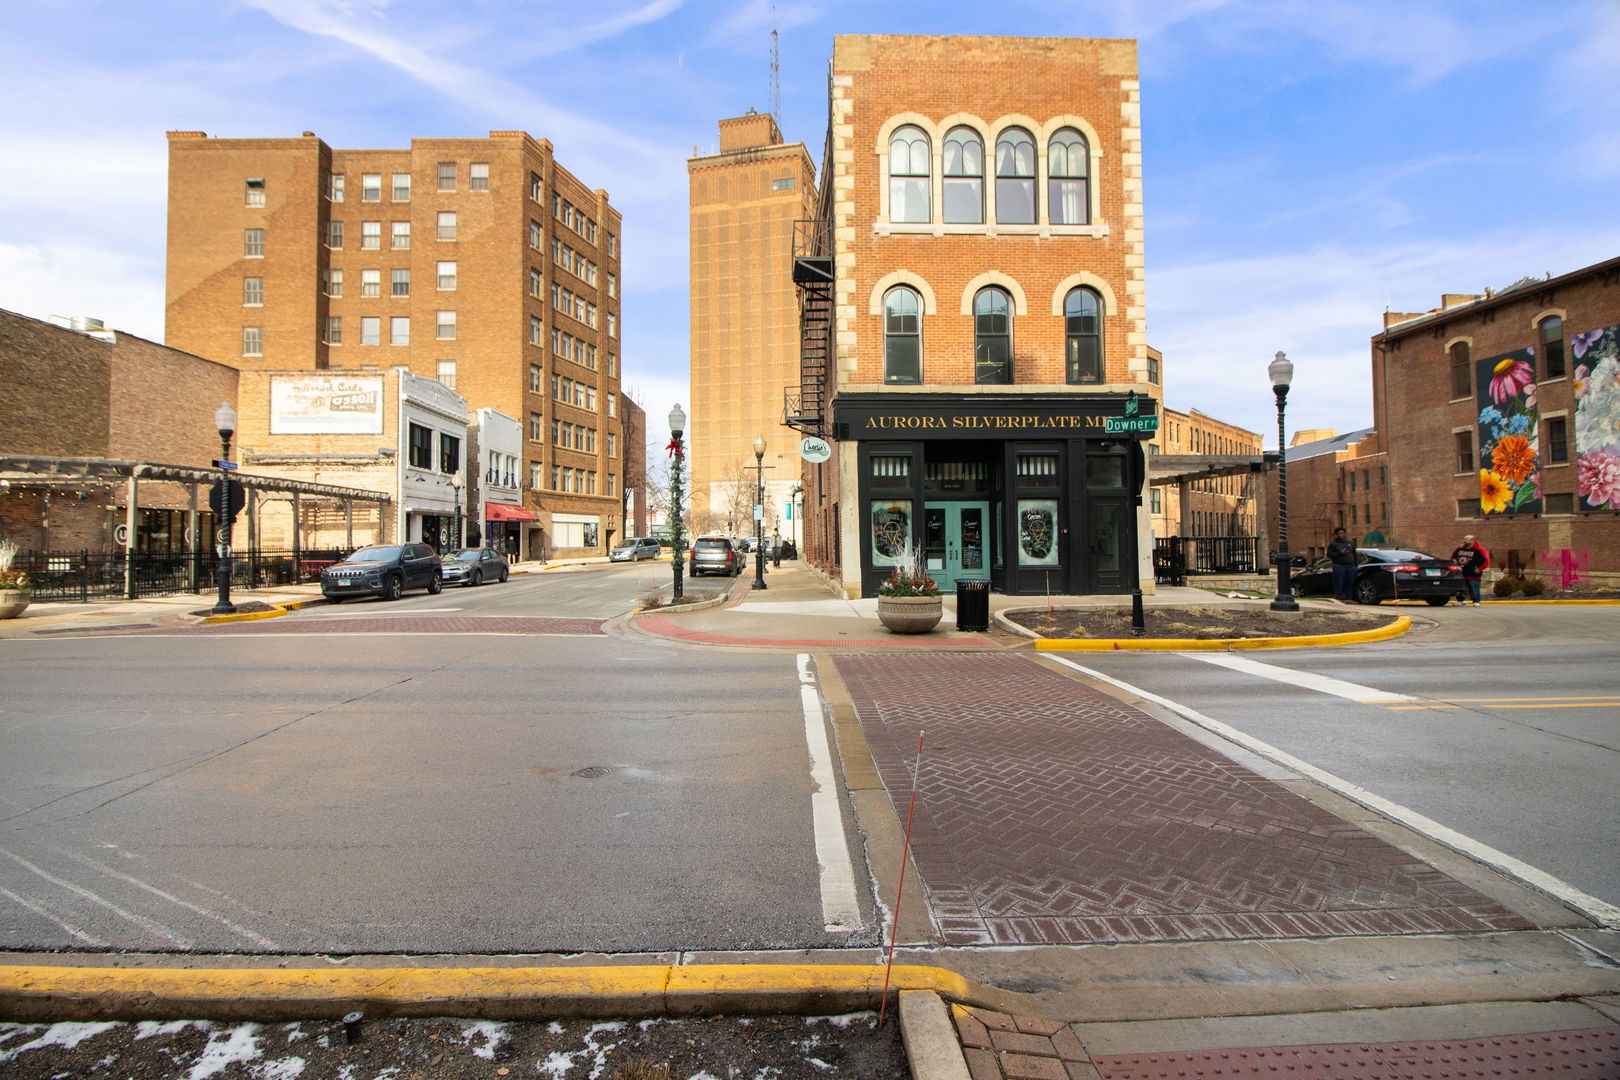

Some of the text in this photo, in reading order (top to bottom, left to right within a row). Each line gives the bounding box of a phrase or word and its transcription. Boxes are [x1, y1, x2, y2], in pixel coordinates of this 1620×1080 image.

[865, 416, 948, 429] AURORA
[952, 416, 1081, 428] SILVERPLATE
[1106, 419, 1150, 431] Downer
